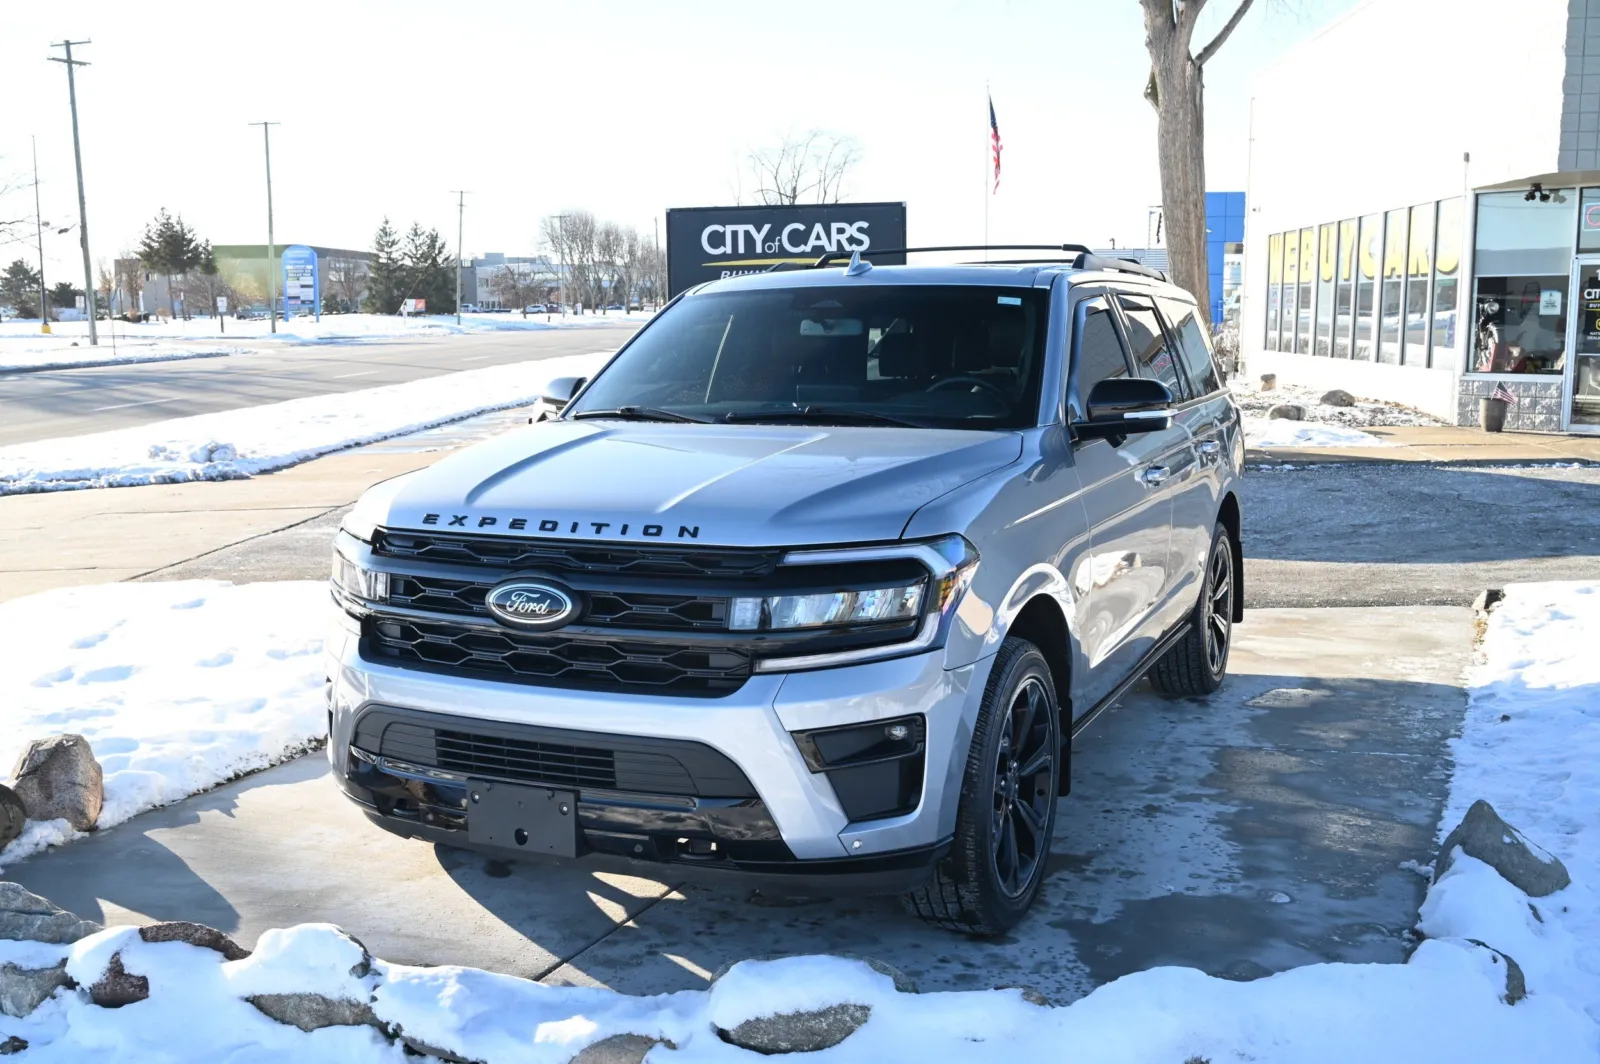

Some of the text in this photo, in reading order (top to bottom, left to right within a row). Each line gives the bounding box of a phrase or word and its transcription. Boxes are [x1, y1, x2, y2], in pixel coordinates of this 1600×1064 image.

[701, 221, 870, 255] CITY of CARS
[422, 513, 700, 538] EXPEDITION
[506, 590, 551, 615] Ford
